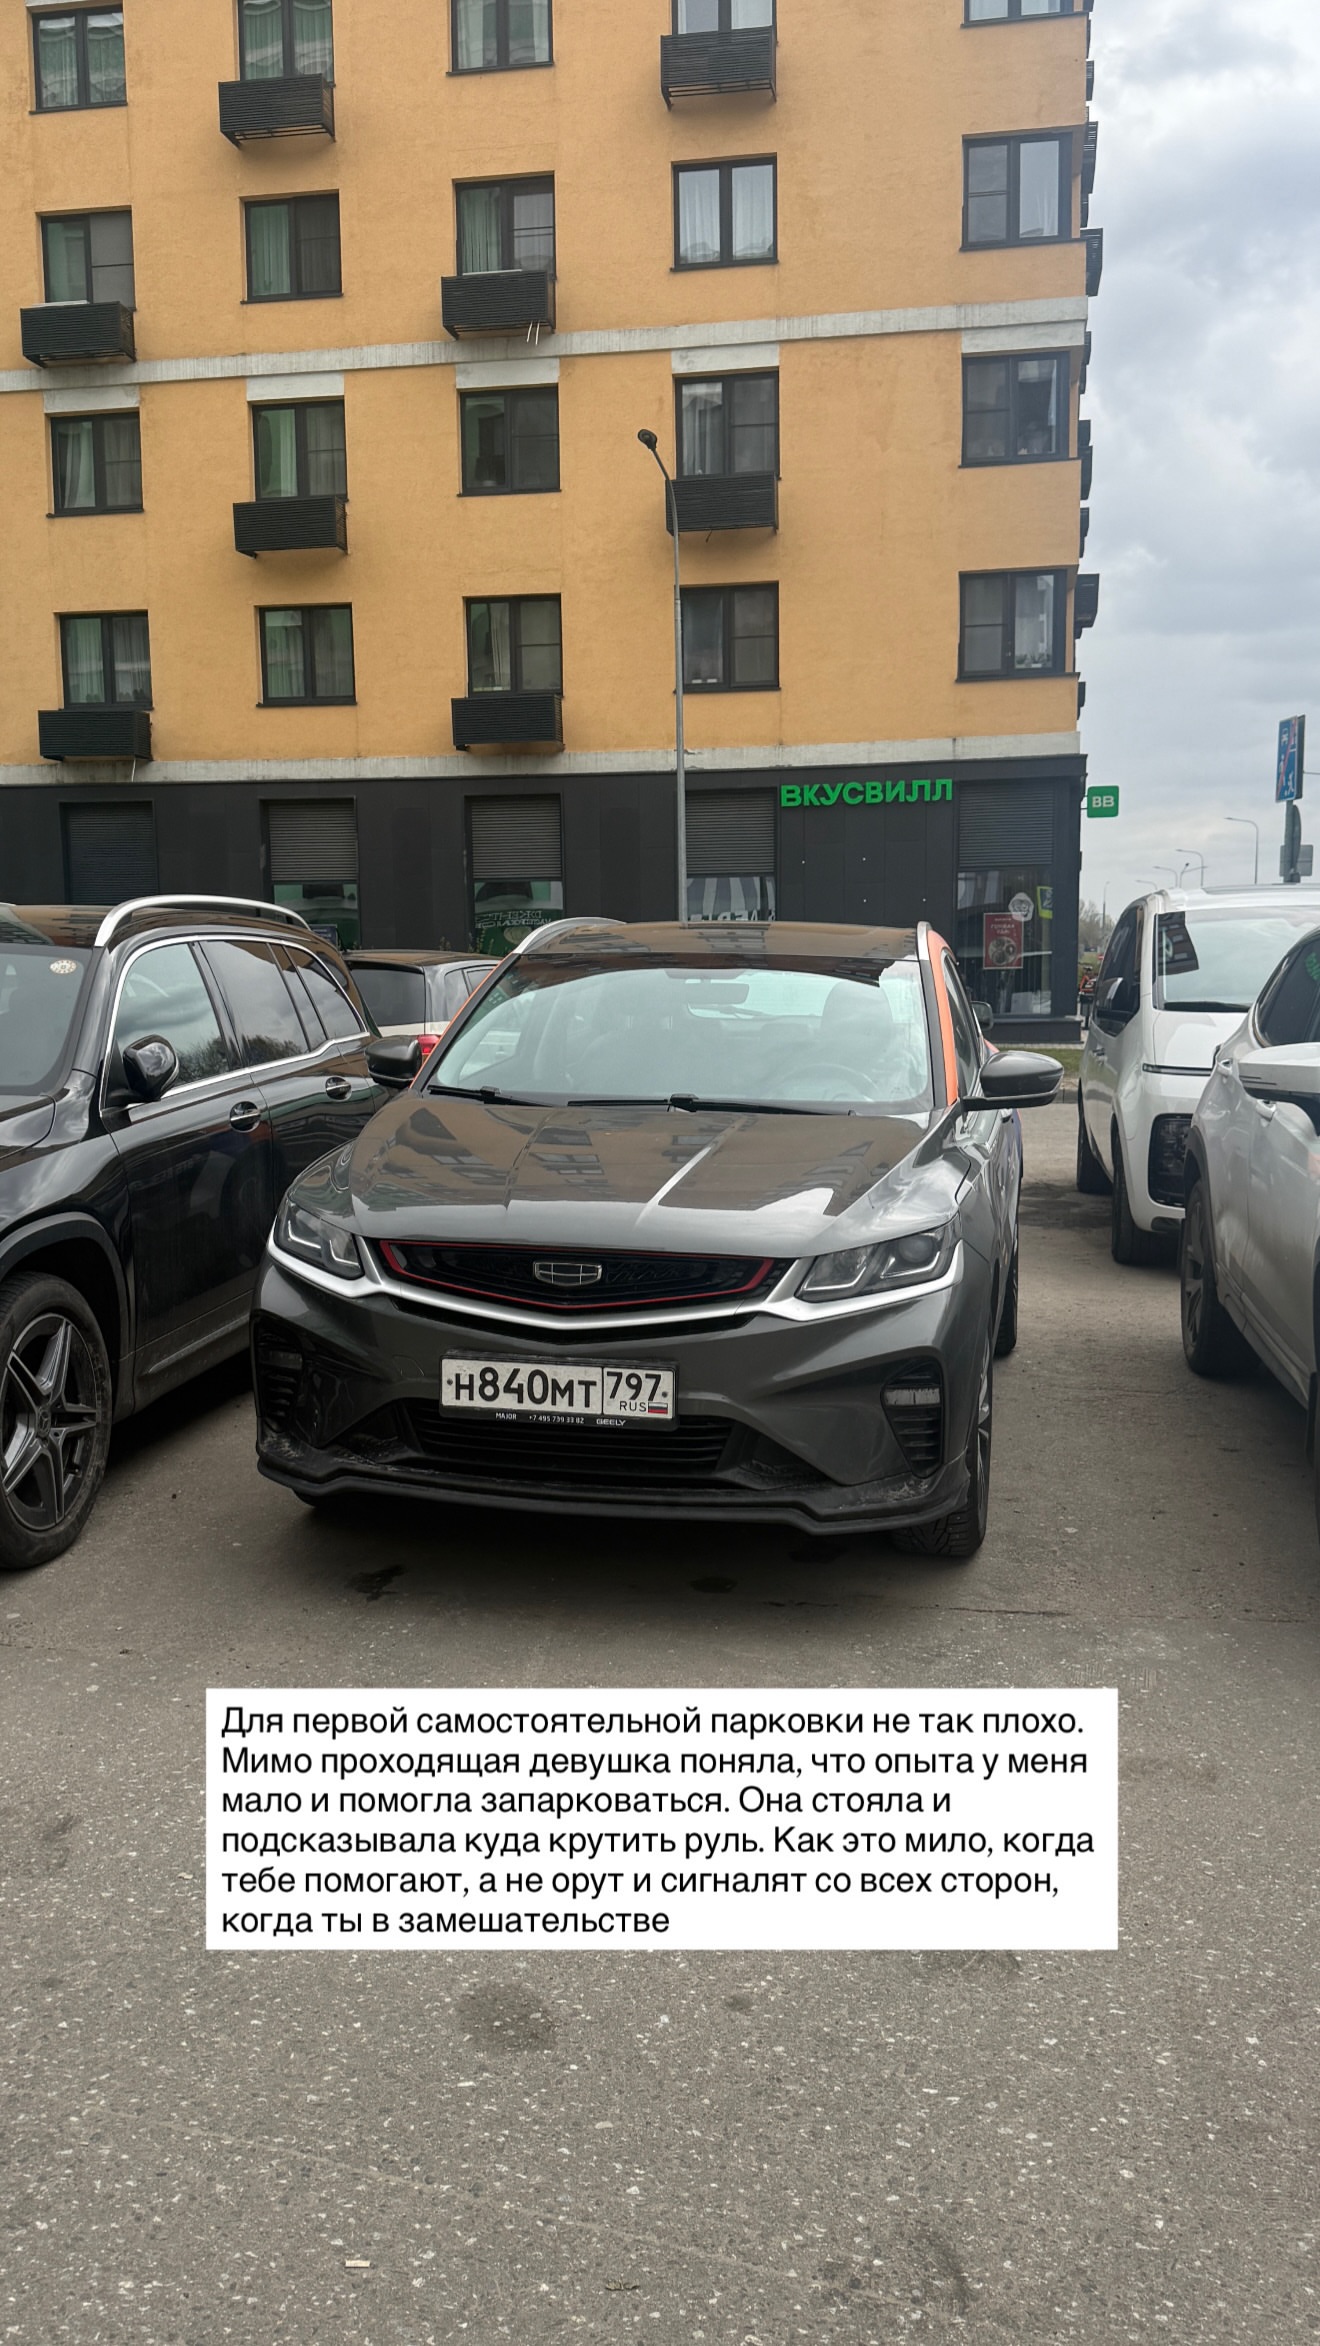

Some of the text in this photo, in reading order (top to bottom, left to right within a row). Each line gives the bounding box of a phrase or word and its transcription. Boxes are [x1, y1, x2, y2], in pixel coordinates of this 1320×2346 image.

[781, 778, 953, 807] ВКУСВИЛЛ
[1092, 795, 1115, 808] ВВ
[454, 1366, 662, 1408] Н840МТ 797
[619, 1401, 647, 1412] RUS
[495, 1412, 517, 1420] MAJOR
[596, 1418, 626, 1426] GEELY
